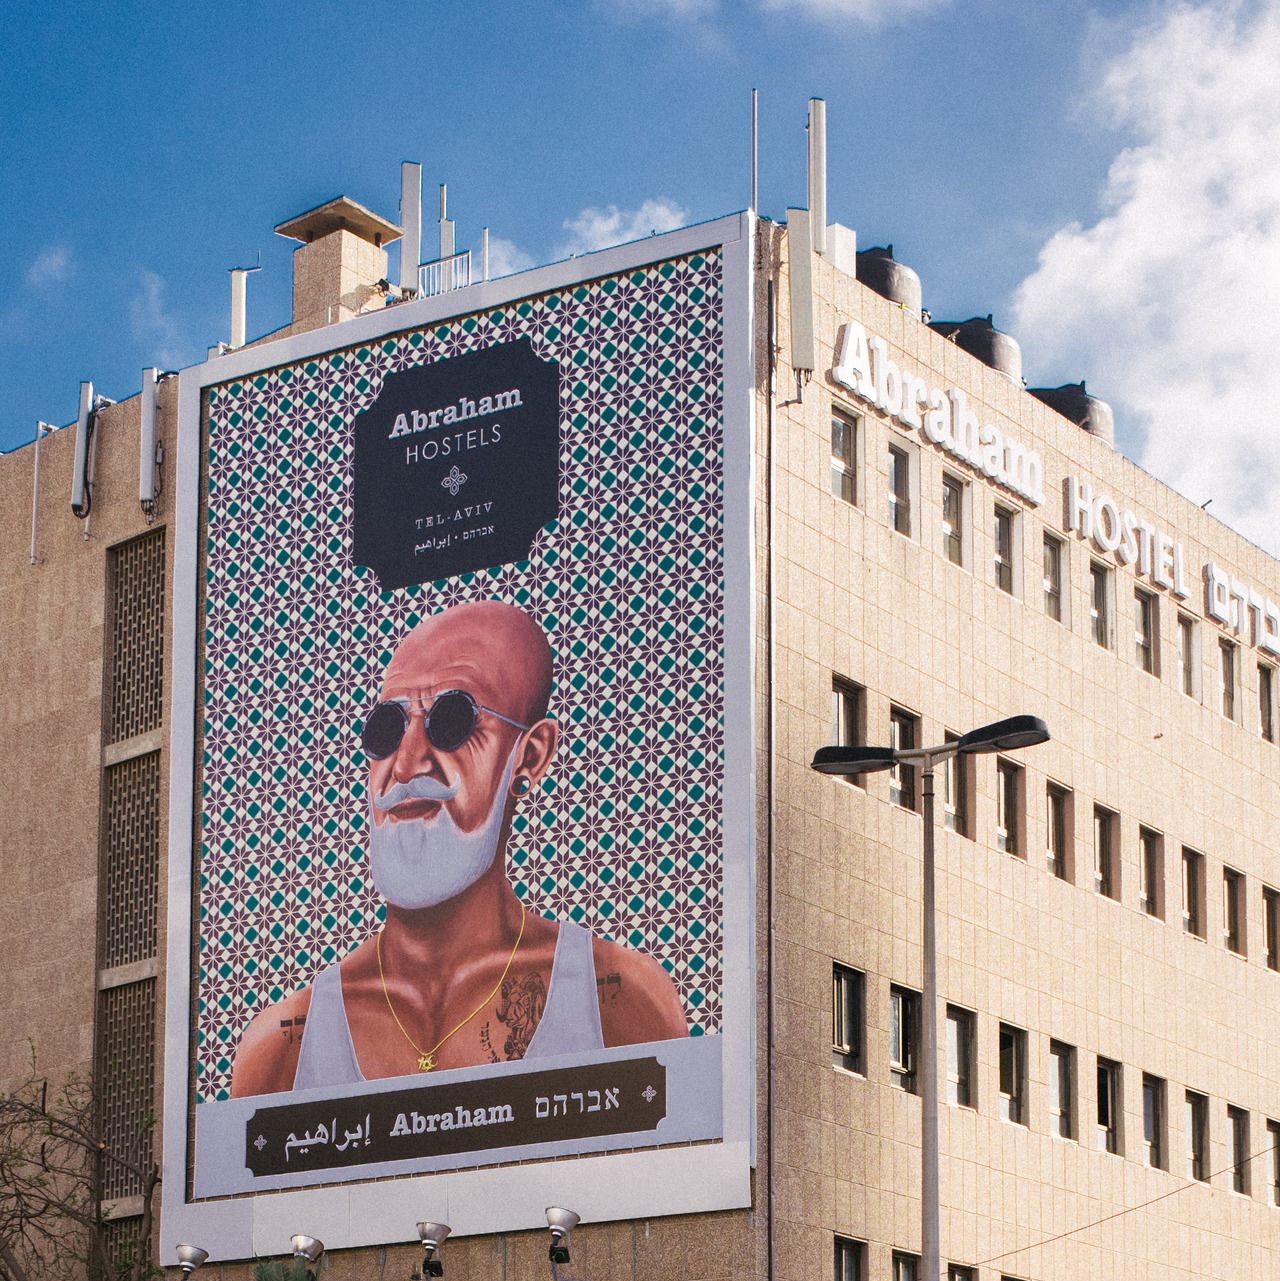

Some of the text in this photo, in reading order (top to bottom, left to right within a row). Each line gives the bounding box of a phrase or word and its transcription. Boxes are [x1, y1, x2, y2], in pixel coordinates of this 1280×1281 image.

[388, 389, 523, 439] Abraham
[406, 424, 501, 464] HOSTELS
[833, 322, 1191, 599] Abraham HOSTEL
[415, 502, 493, 529] TEL-AVIV
[390, 1104, 514, 1137] Abraham
[535, 1087, 620, 1118] אברהם
